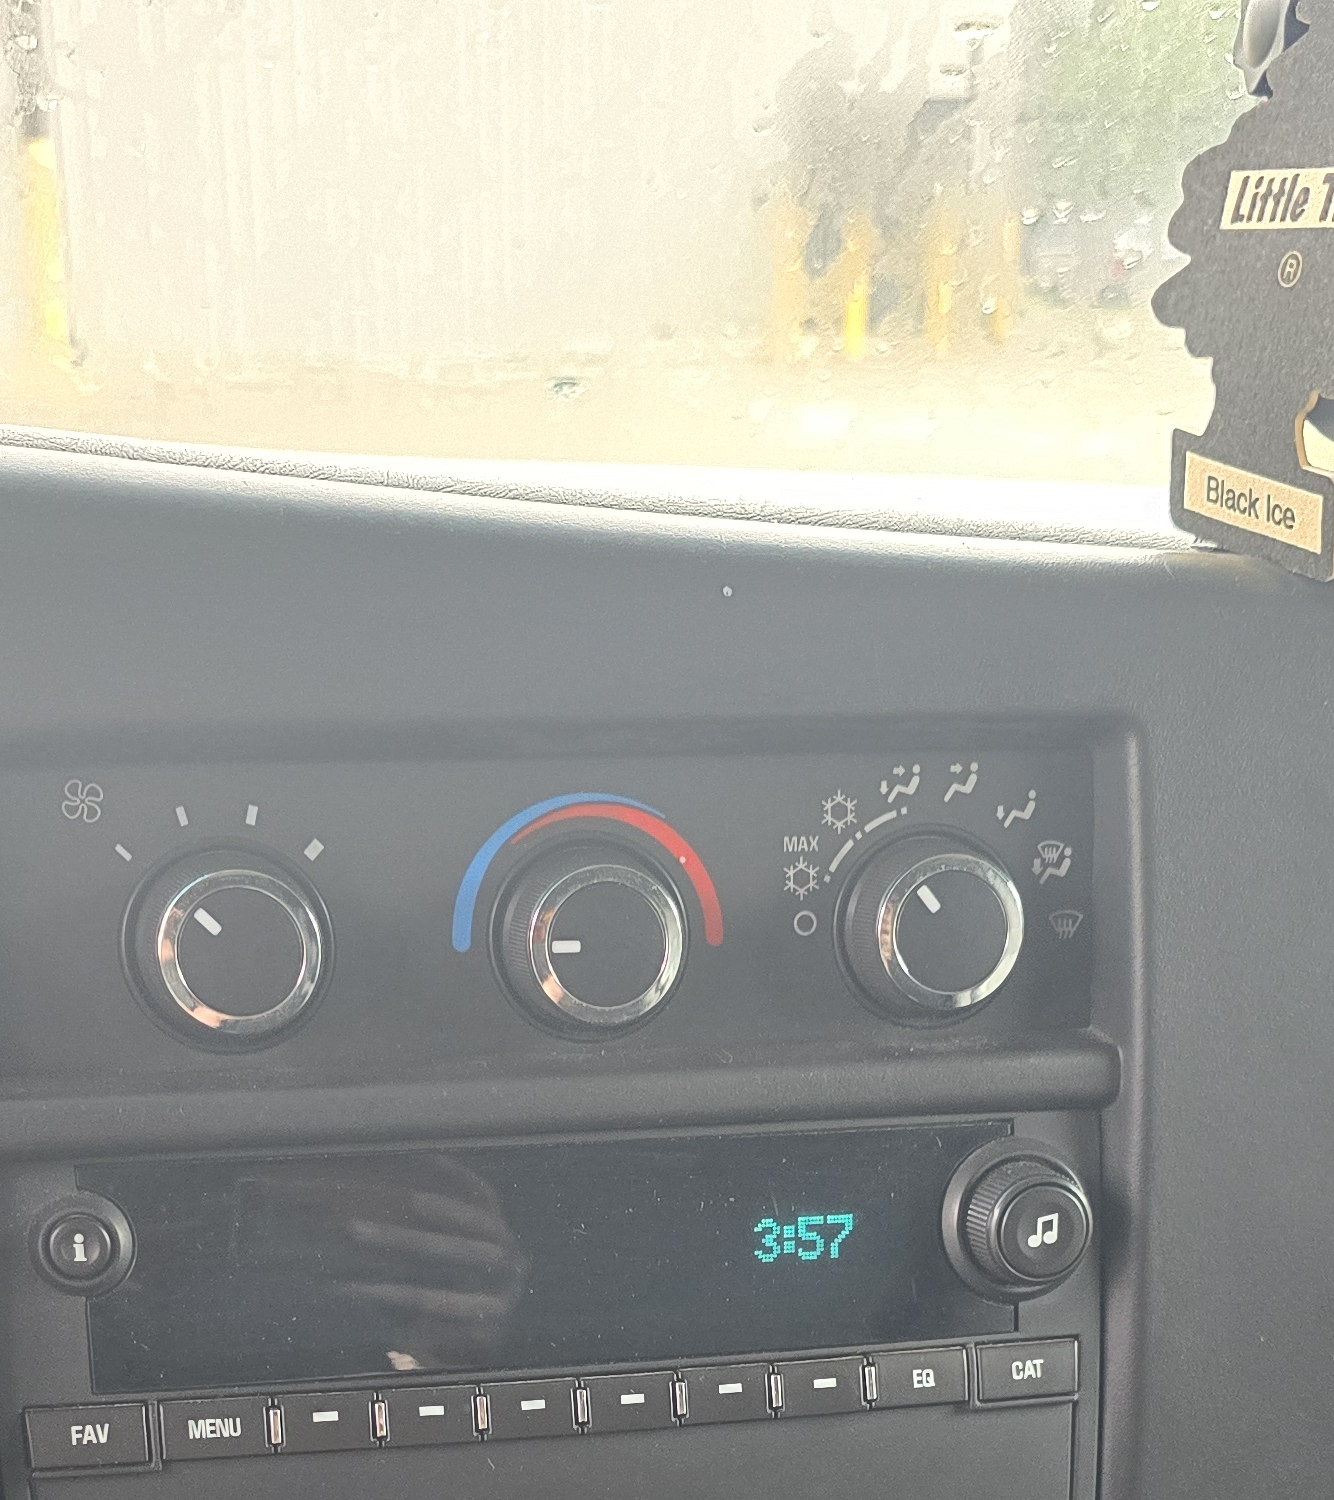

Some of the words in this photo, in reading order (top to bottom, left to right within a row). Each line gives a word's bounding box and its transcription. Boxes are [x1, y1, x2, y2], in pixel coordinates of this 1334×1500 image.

[1230, 173, 1310, 225] Little
[1206, 475, 1260, 520] Black
[1266, 494, 1296, 530] Ice
[783, 835, 819, 852] MAX
[754, 1213, 854, 1263] 3:57
[912, 1368, 936, 1388] EQ
[1011, 1359, 1045, 1380] CAT
[70, 1422, 110, 1446] FAV
[187, 1417, 242, 1440] MENU
